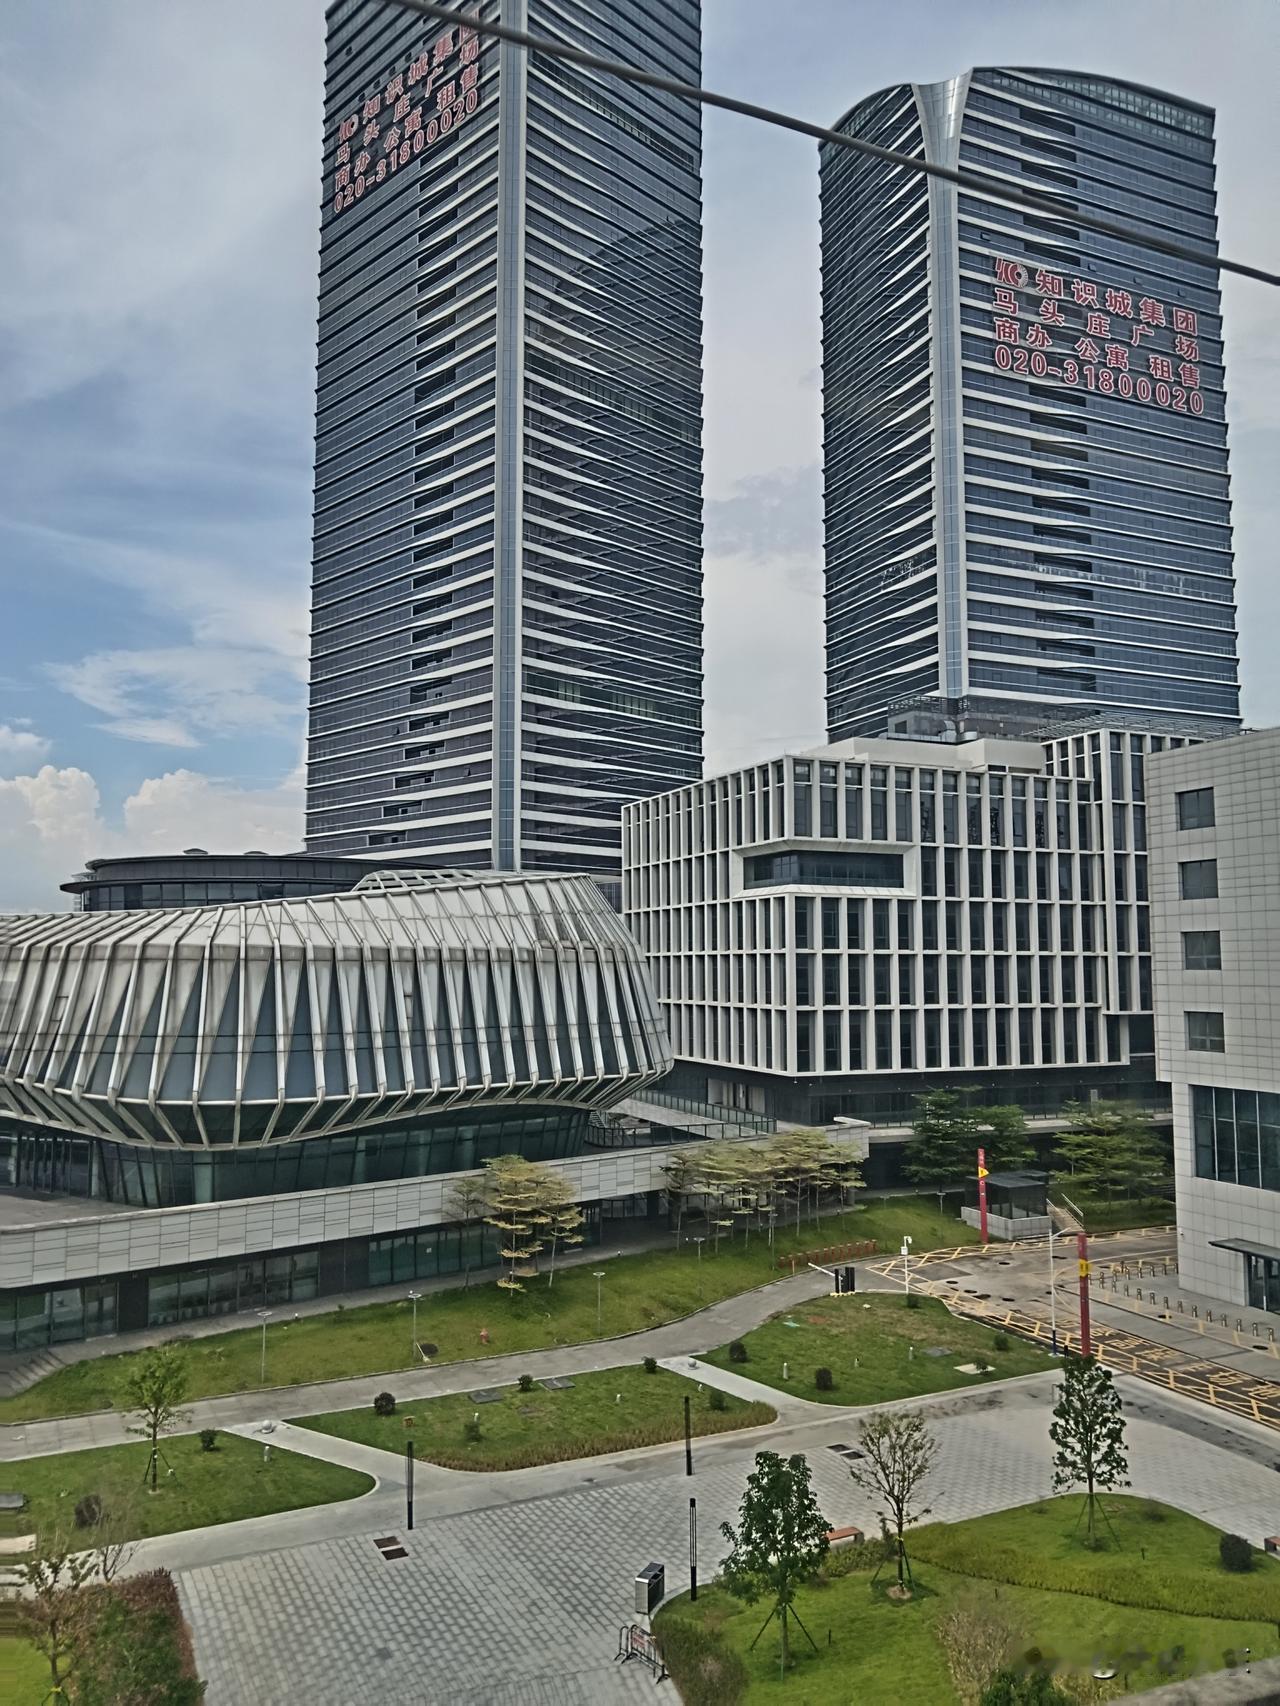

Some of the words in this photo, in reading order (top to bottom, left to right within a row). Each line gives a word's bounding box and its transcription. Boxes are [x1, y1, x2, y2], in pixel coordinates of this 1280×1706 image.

[335, 35, 480, 166] 马头庄广场
[333, 88, 478, 214] 020-31800020
[994, 288, 1199, 361] 马头庄广场
[1035, 269, 1198, 336] 知识城集团
[995, 345, 1204, 415] 020-31800020
